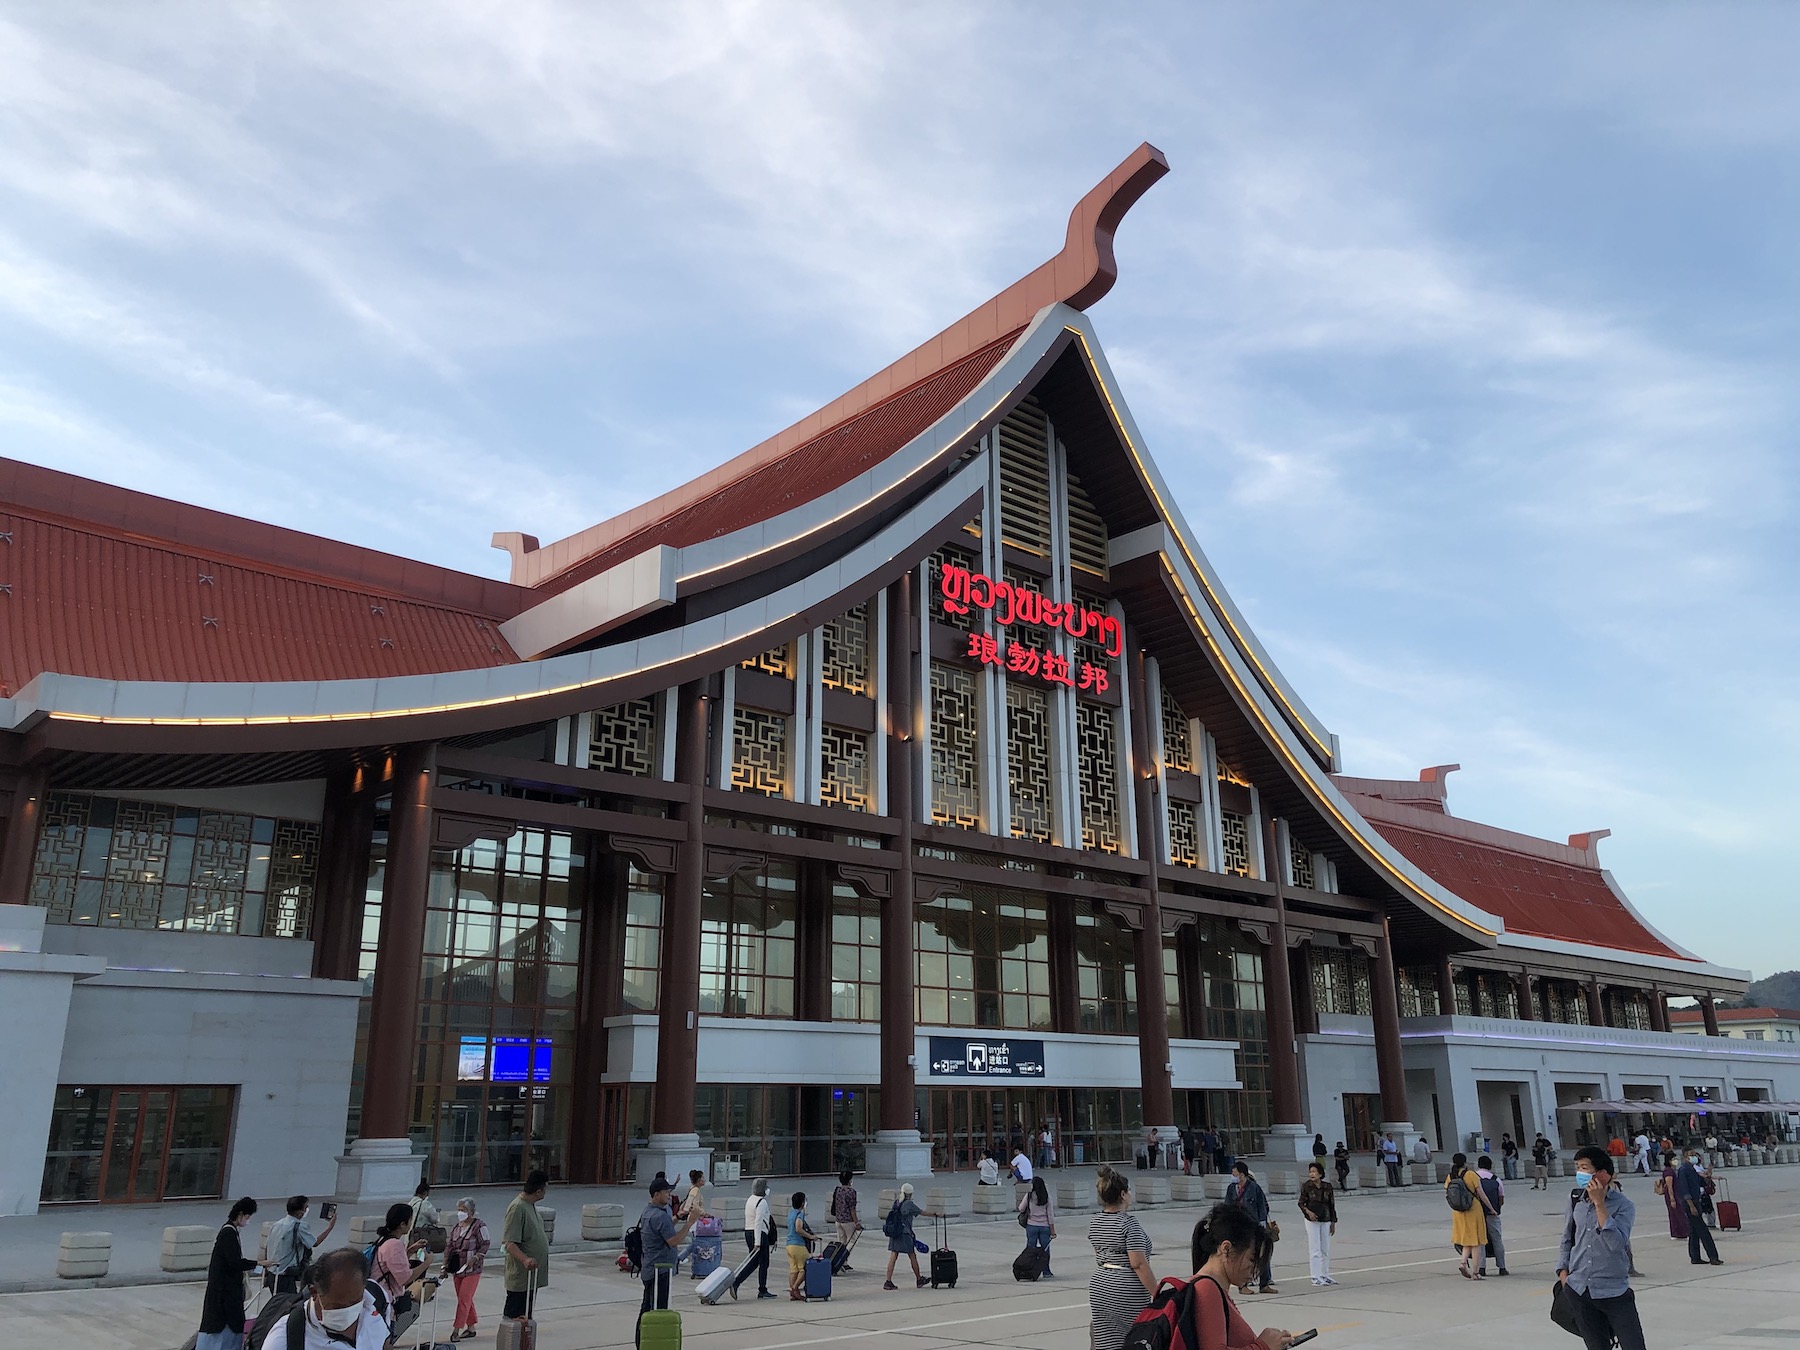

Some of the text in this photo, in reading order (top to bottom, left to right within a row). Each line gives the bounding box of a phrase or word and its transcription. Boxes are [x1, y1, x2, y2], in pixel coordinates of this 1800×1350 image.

[967, 632, 1109, 695] 琅勃拉邦
[988, 1066, 1012, 1074] Entrance
